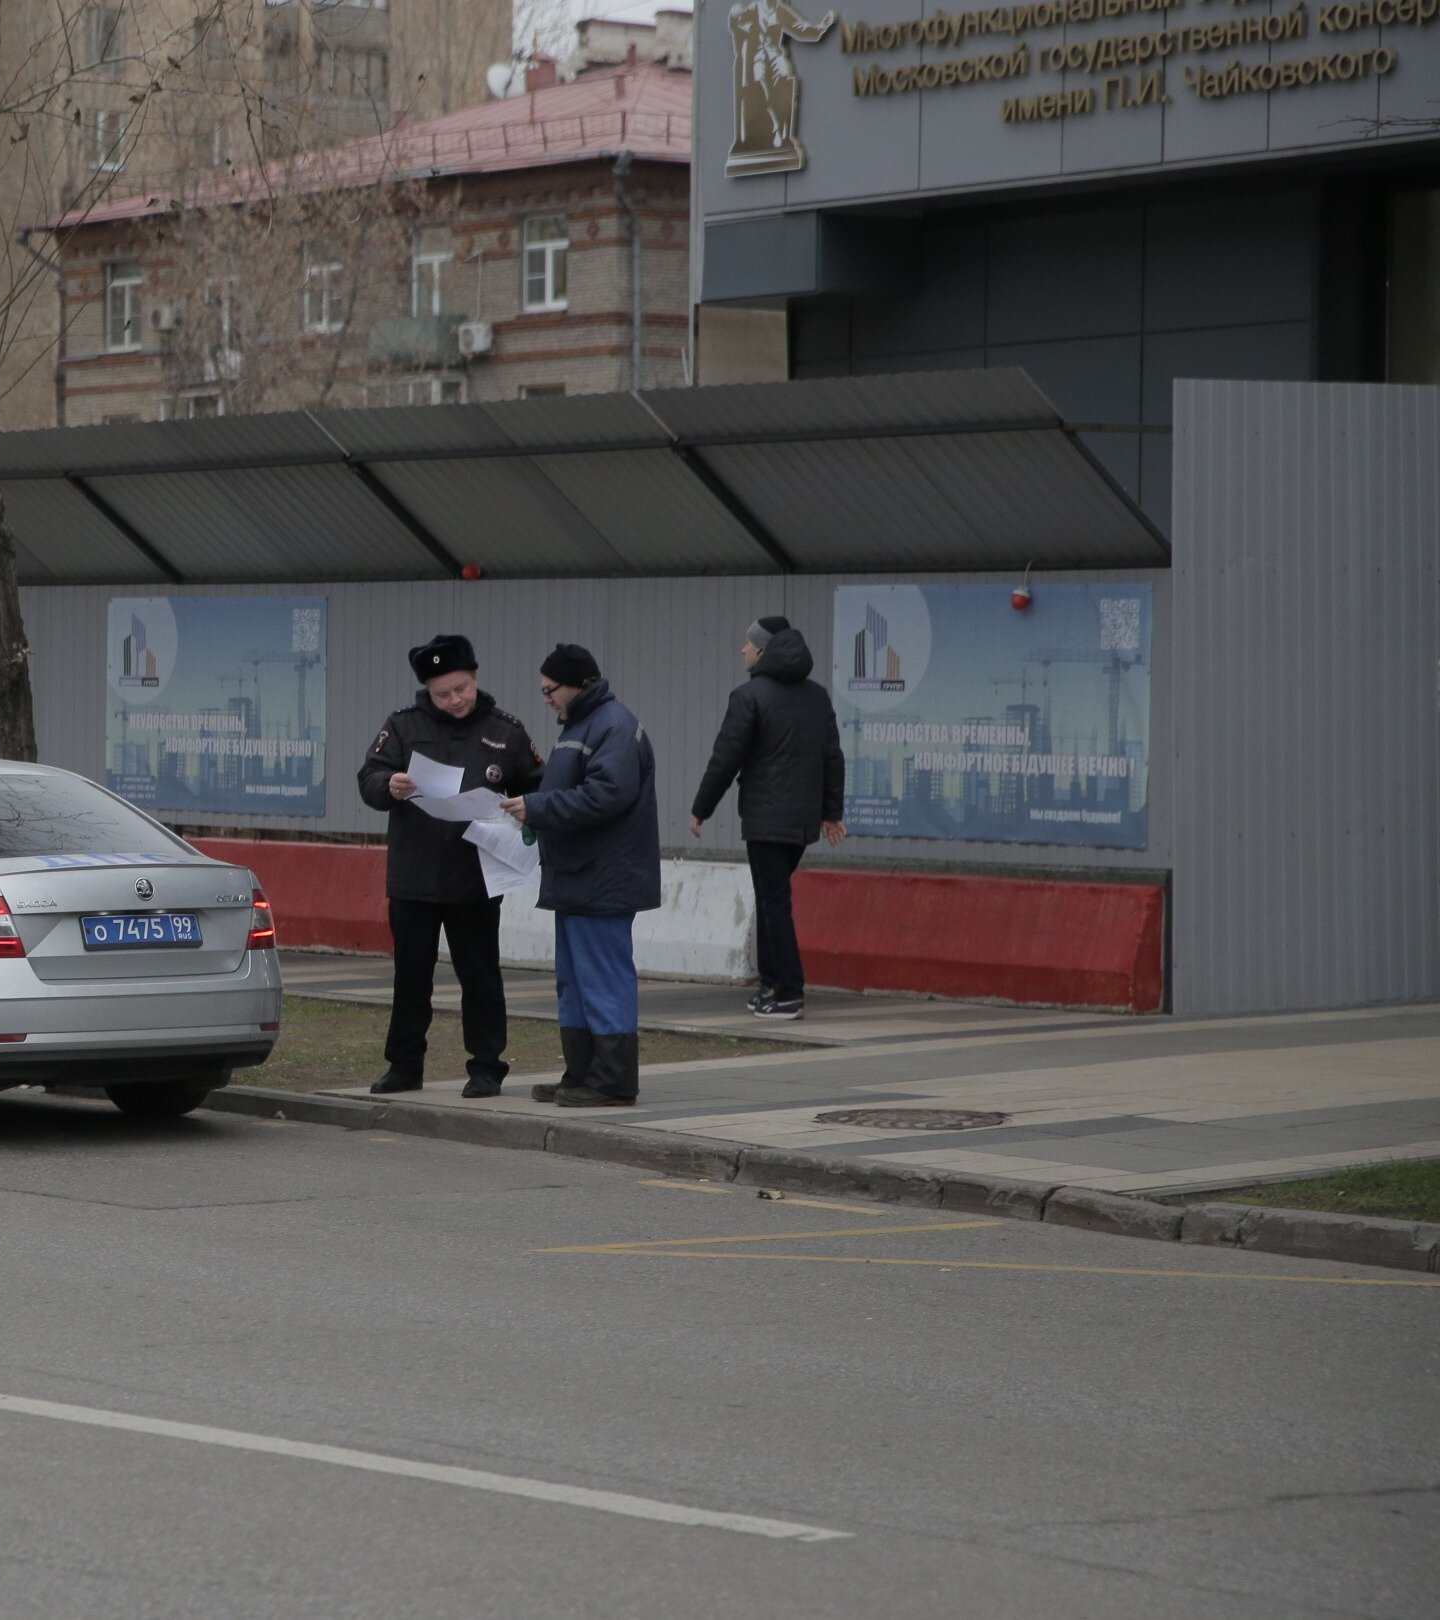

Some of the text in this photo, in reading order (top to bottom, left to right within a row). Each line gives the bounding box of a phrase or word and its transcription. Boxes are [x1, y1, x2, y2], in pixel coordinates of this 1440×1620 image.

[841, 0, 1180, 53] Многофункциональн
[853, 0, 1440, 96] Московской государственной консер
[1002, 46, 1396, 122] имени П.И. Чайковского
[130, 713, 191, 731] НЕУДОБСТВА
[864, 722, 949, 742] НЕУДОБСТВА
[914, 751, 1009, 773] КОМФОРТНОЕ
[1011, 753, 1075, 776] БУДУЩЕЕ
[1078, 756, 1127, 777] ВЕЧНО
[113, 918, 164, 941] 7475
[173, 917, 192, 933] 99
[178, 932, 192, 940] RUS
